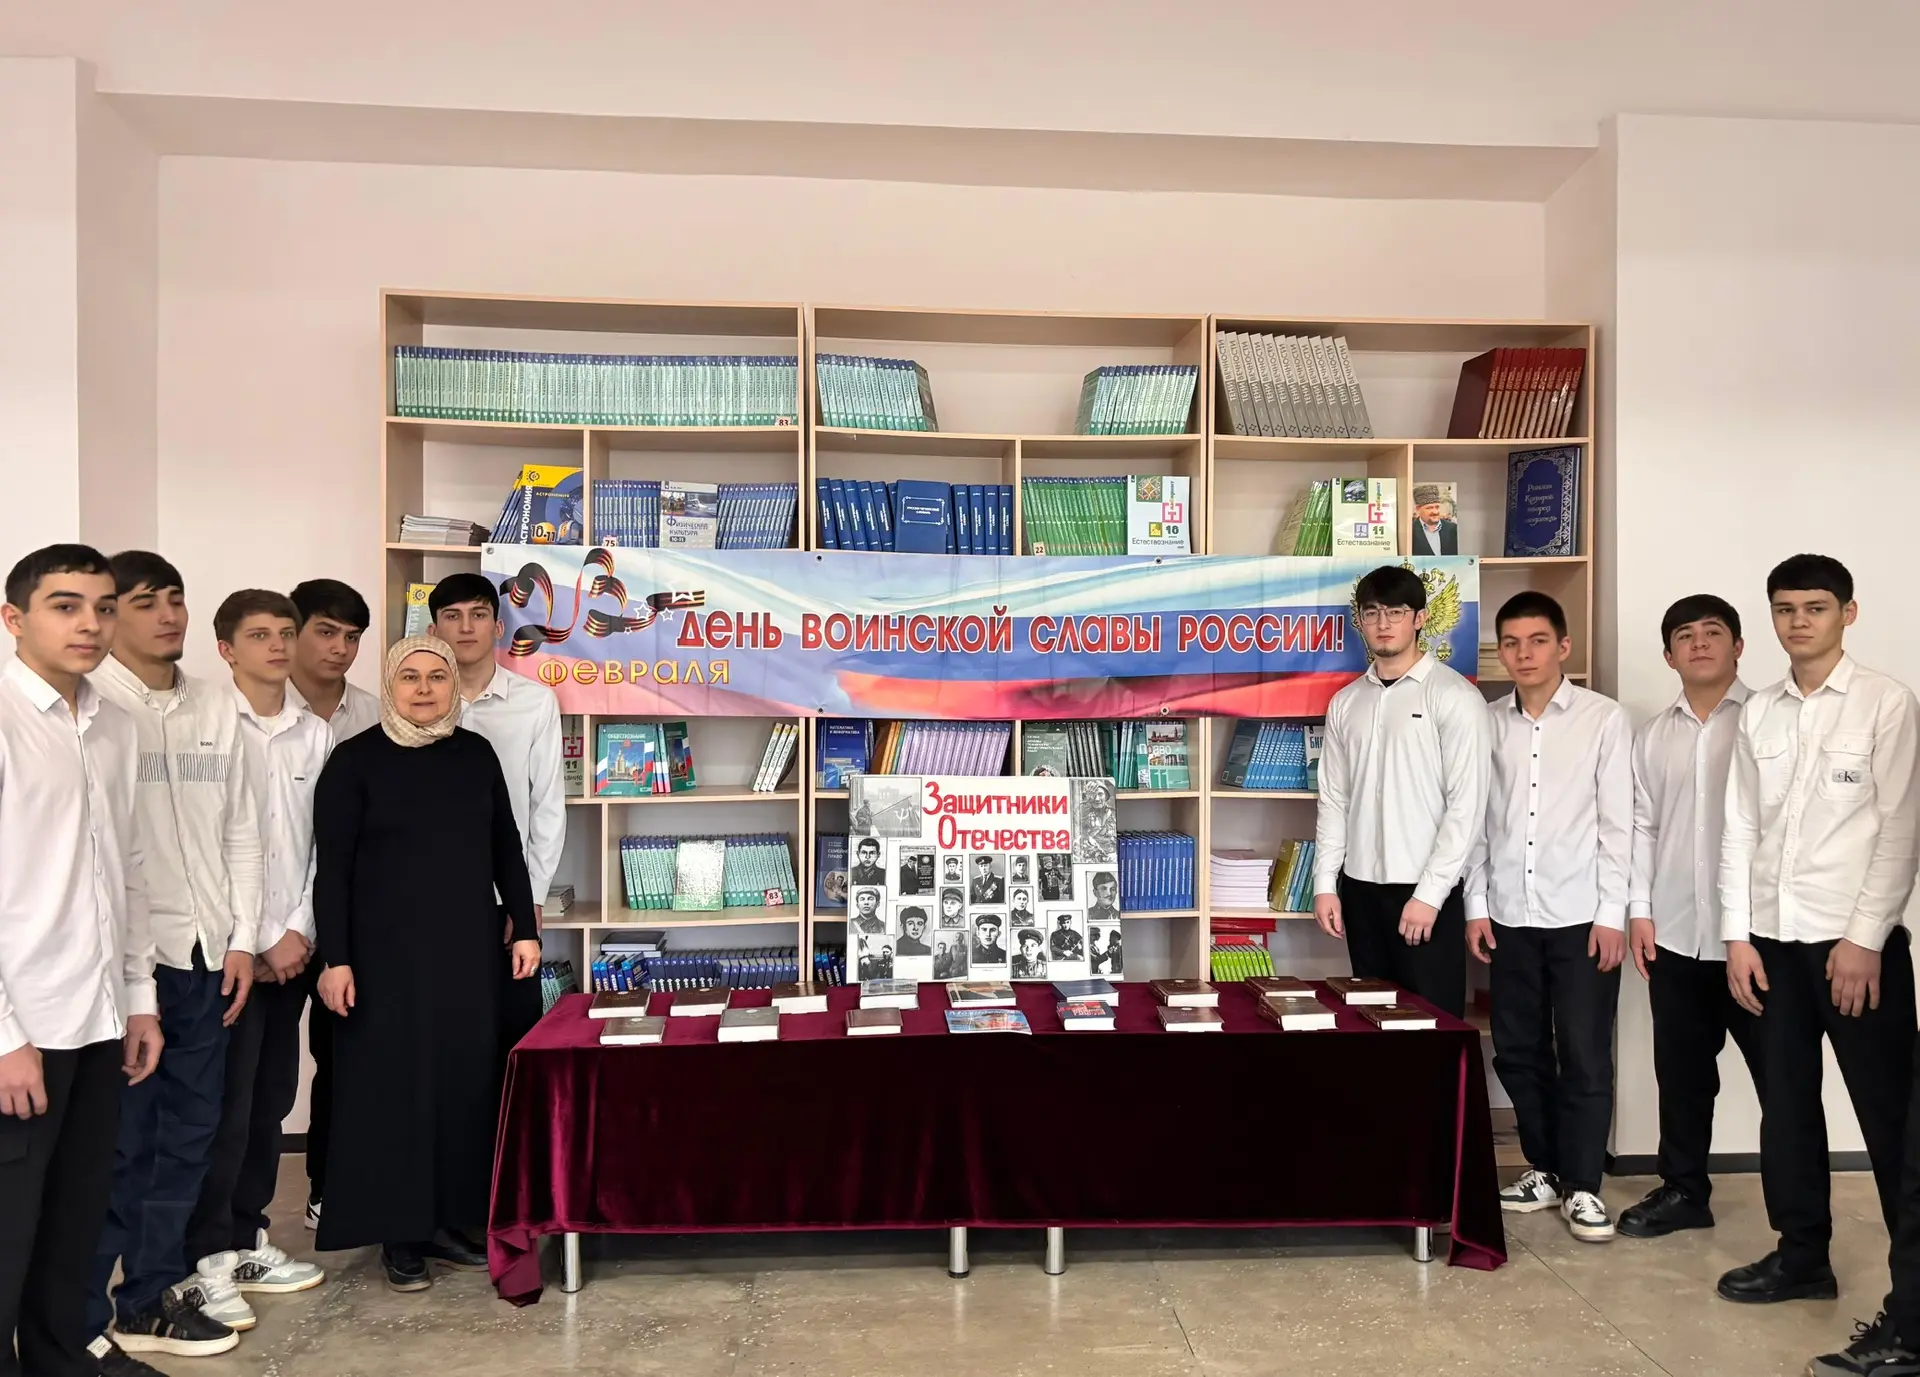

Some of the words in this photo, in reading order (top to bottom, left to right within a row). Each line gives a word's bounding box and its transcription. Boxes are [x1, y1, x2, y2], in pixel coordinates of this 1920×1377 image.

[520, 485, 533, 544] АСТРОНОМИЯ
[1166, 525, 1179, 534] 10
[1373, 526, 1384, 535] 11
[1034, 545, 1044, 554] 22
[676, 610, 782, 650] ДЕНЬ
[802, 605, 1013, 653] ВОИНСКОЙ
[1029, 613, 1161, 654] СЛАВЫ
[1178, 613, 1344, 653] РОССИИ!
[538, 658, 730, 686] ФЕВРАЛЯ
[566, 761, 577, 769] 11
[922, 780, 1068, 816] Защитники
[938, 815, 1070, 850] Отечества
